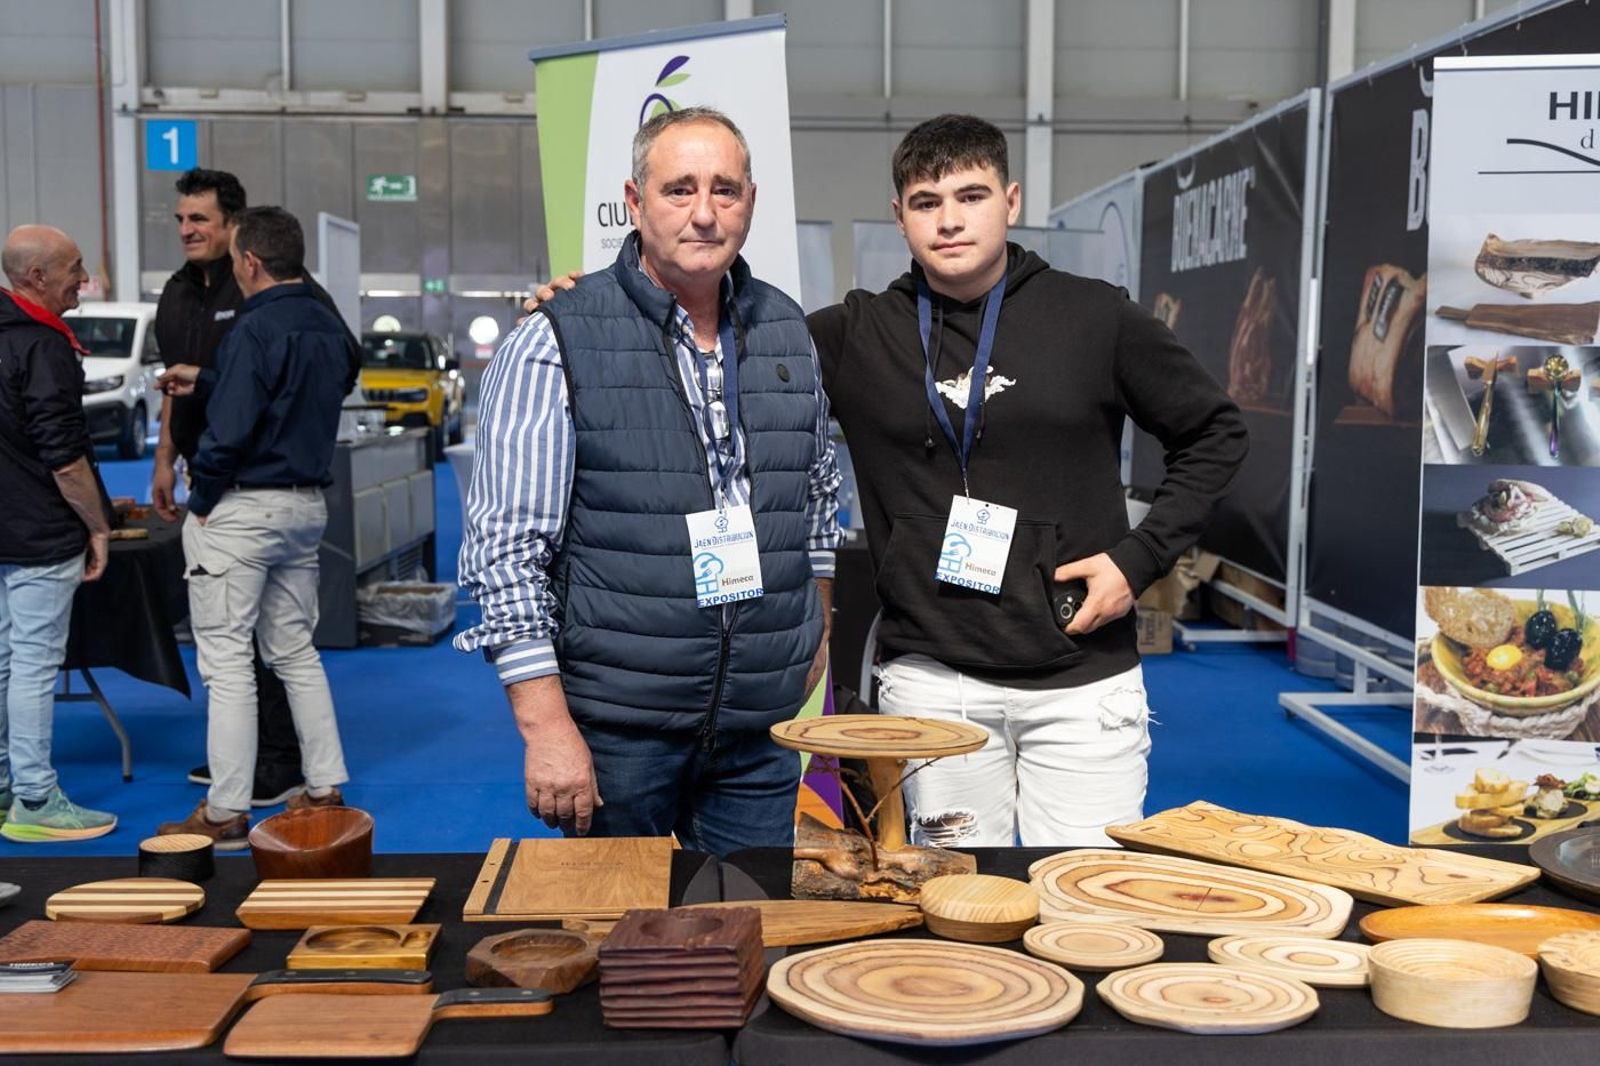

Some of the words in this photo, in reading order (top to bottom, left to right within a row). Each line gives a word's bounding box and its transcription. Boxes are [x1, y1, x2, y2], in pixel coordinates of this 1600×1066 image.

[1549, 91, 1600, 120] HI
[162, 127, 179, 165] 1
[1407, 108, 1431, 231] B
[598, 202, 634, 227] CIU
[722, 575, 754, 586] Himeca
[935, 571, 1001, 595] EXPOSITOR
[697, 587, 764, 607] EXPOSITOR
